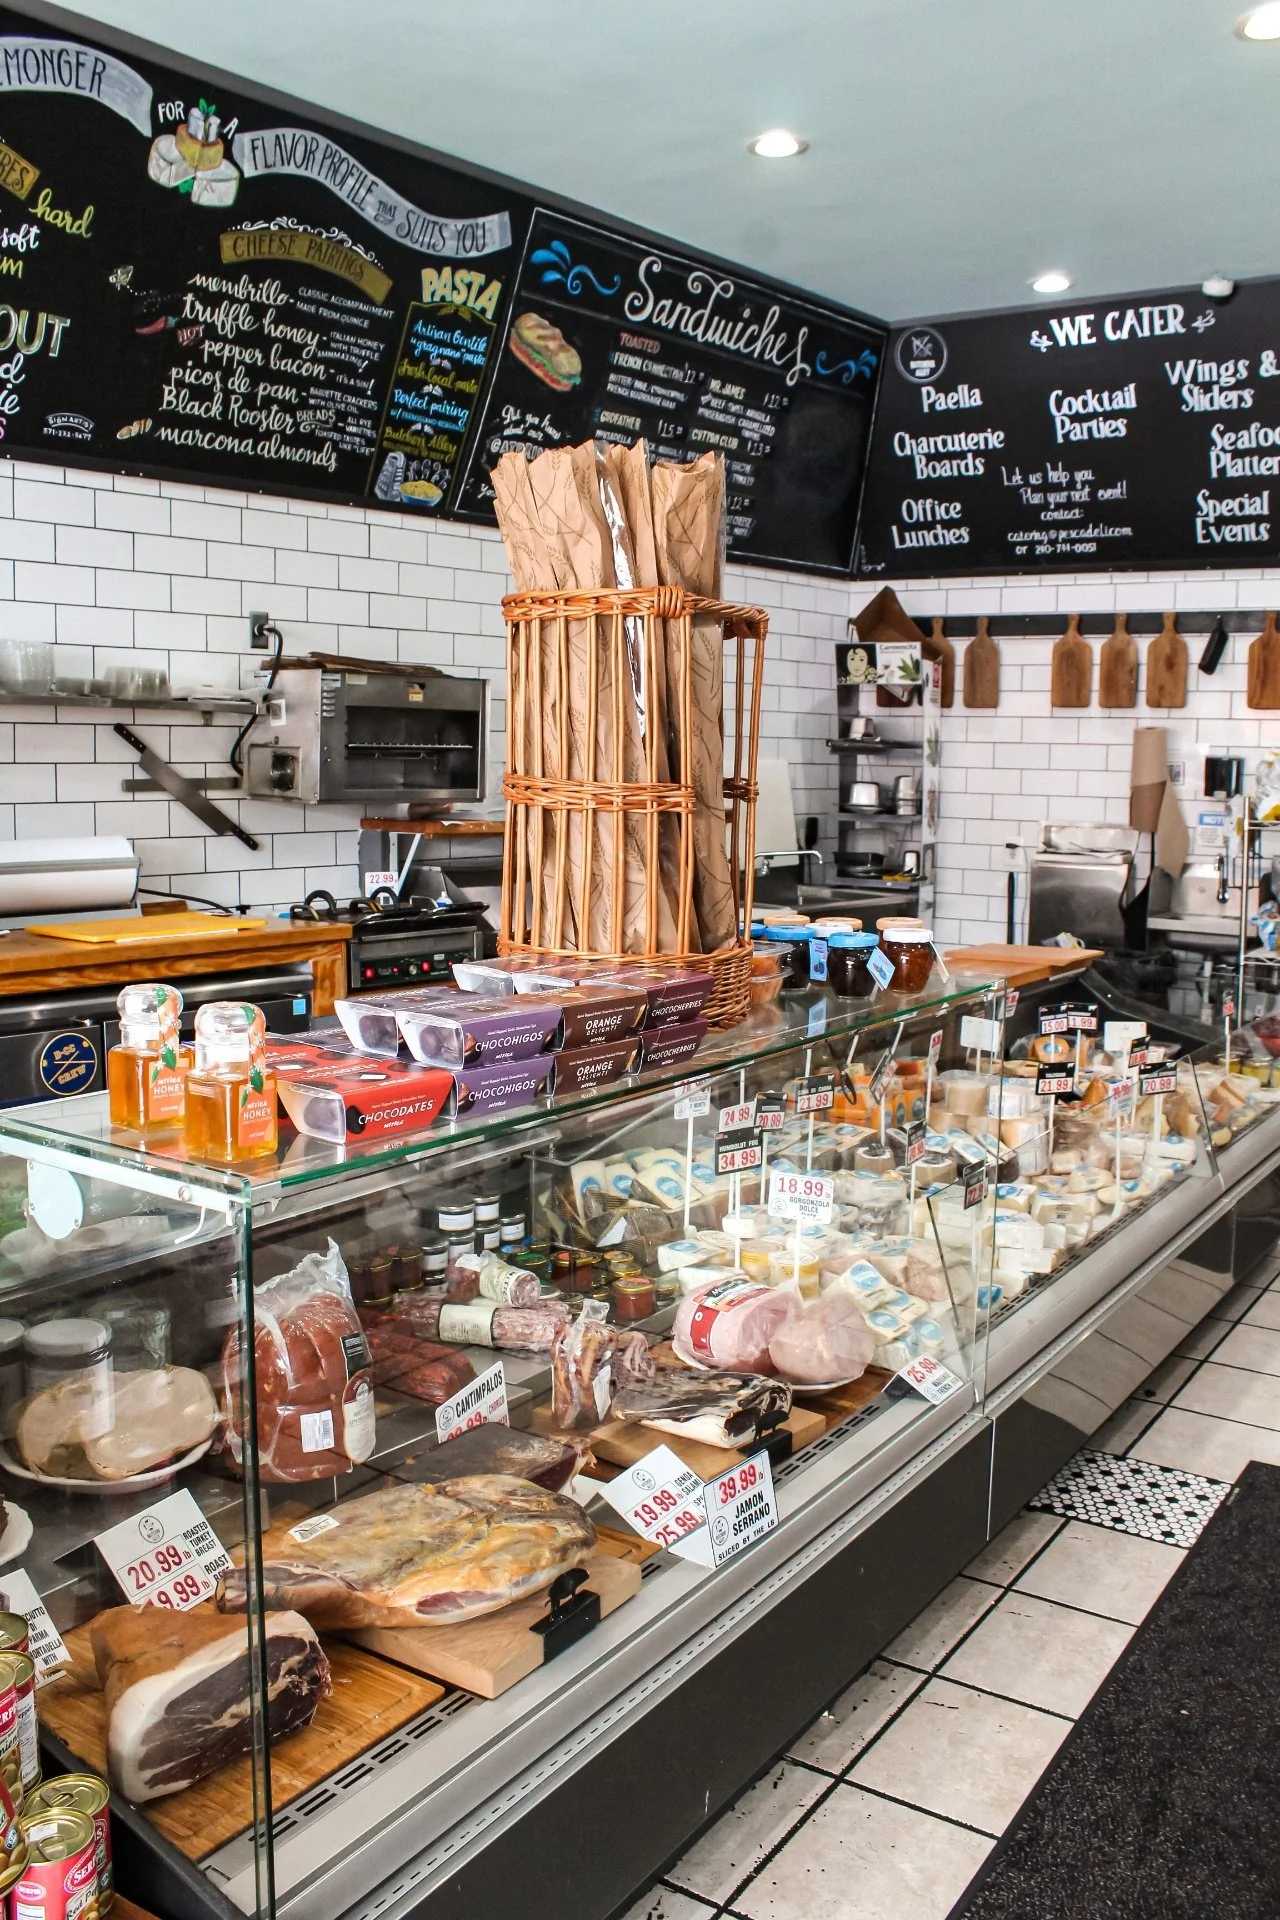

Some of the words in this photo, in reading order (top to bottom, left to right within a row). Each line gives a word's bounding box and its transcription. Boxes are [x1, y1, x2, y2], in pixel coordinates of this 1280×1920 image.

[0, 48, 106, 98] MONGER
[158, 100, 185, 123] FOR
[223, 117, 238, 140] A
[250, 132, 319, 172] FLAVOR
[319, 145, 379, 213] PROFILE
[377, 200, 397, 217] THAT
[396, 208, 446, 252] SUITS
[453, 222, 487, 255] YOU
[29, 188, 94, 238] hard
[232, 234, 295, 259] CHEESE
[304, 237, 365, 281] PAIRINGS
[298, 287, 328, 301] CLASSIC
[330, 295, 395, 319] ACCOMPANIMENT
[421, 266, 502, 320] PASTA
[181, 292, 260, 339] truffle
[262, 311, 320, 359] honey
[330, 331, 356, 343] ITALIAN
[357, 337, 386, 352] HONEY
[296, 301, 316, 313] MADE
[318, 307, 340, 320] FROM
[340, 314, 370, 329] QUINCE
[624, 256, 811, 387] Sandwiches
[1049, 313, 1097, 347] WE
[1104, 304, 1186, 341] CATER
[176, 325, 205, 342] HOT
[412, 319, 452, 343] Artisan
[619, 331, 661, 354] TOASTED
[200, 339, 264, 369] pepper
[270, 343, 328, 380] bacon
[348, 378, 355, 386] A
[330, 342, 348, 351] WITH
[349, 346, 380, 361] TRUFFLE
[613, 351, 642, 371] FRENCH
[1165, 358, 1250, 386] Wings
[169, 360, 222, 392] picos
[228, 365, 252, 393] de
[257, 380, 299, 407] pan
[343, 394, 378, 411] CRACKERS
[722, 383, 746, 399] JAMES
[159, 384, 223, 420] Black
[228, 395, 295, 434] Rooster
[296, 408, 336, 423] BREADS
[347, 416, 358, 425] ALL
[359, 418, 372, 428] RYE
[308, 397, 325, 407] WITH
[326, 400, 346, 411] OLIVE
[394, 388, 429, 409] Perfect
[430, 400, 469, 426] pairing
[920, 383, 983, 413] Paella
[1049, 382, 1138, 417] Cocktail
[1181, 382, 1254, 413] Sliders
[315, 430, 342, 442] TOASTED
[1055, 416, 1128, 444] Parties
[155, 425, 255, 455] marcona
[256, 432, 338, 472] almonds
[339, 443, 352, 451] LIKE
[719, 434, 739, 450] CLUB
[893, 428, 1005, 456] Charcuterie
[915, 453, 985, 480] Boards
[1000, 465, 1024, 486] Let
[1029, 471, 1043, 485] us
[1045, 461, 1070, 487] help
[1019, 487, 1045, 505] Plan
[1046, 491, 1067, 509] your
[1070, 484, 1091, 502] next
[1196, 489, 1271, 521] Special
[902, 498, 962, 523] Office
[891, 524, 970, 549] Lunches
[1196, 517, 1271, 544] Events
[1015, 545, 1028, 555] or
[370, 874, 394, 884] 22.99
[651, 1000, 703, 1017] CHOCOCHERRIES
[585, 1015, 623, 1030] ORANGE
[586, 1025, 618, 1036] DELIGHTS
[475, 1031, 544, 1052] CHOCOHIGOS
[647, 1043, 697, 1062] CHOCOCHERRIES
[576, 1060, 614, 1077] ORANGE
[577, 1070, 609, 1082] DELIGHTS
[153, 1084, 185, 1095] HONEY
[468, 1080, 537, 1101] CHOCOHIGOS
[243, 1107, 271, 1120] HONEY
[358, 1100, 434, 1125] CHOCODATES
[724, 1106, 750, 1126] 24.99
[719, 1142, 747, 1152] HUMBOLDT
[748, 1139, 759, 1147] FOG
[720, 1149, 756, 1170] 34.99
[777, 1177, 824, 1197] 18.99
[789, 1197, 830, 1208] GORGONZOLA
[799, 1205, 819, 1214] DOLCE
[906, 1357, 937, 1384] 25.99
[455, 1369, 503, 1418] CANTIMPALOS
[674, 1471, 694, 1488] GENOA
[681, 1479, 704, 1496] SALAMI
[718, 1464, 757, 1504] 39.99
[633, 1489, 677, 1528] 19.99
[735, 1490, 764, 1518] JAMON
[182, 1521, 209, 1541] ROASTED
[732, 1502, 771, 1537] SERRANO
[189, 1531, 213, 1548] TURKEY
[195, 1539, 217, 1557] BREAST
[718, 1543, 740, 1561] SLICED
[742, 1534, 751, 1545] BY
[753, 1525, 764, 1537] THE
[127, 1544, 182, 1590] 20.99
[182, 1549, 192, 1560] lb
[204, 1554, 229, 1575] ROAST
[201, 1579, 210, 1590] lb
[29, 1622, 38, 1632] DI
[29, 1629, 50, 1645] PARMA
[41, 1653, 59, 1666] WITH
